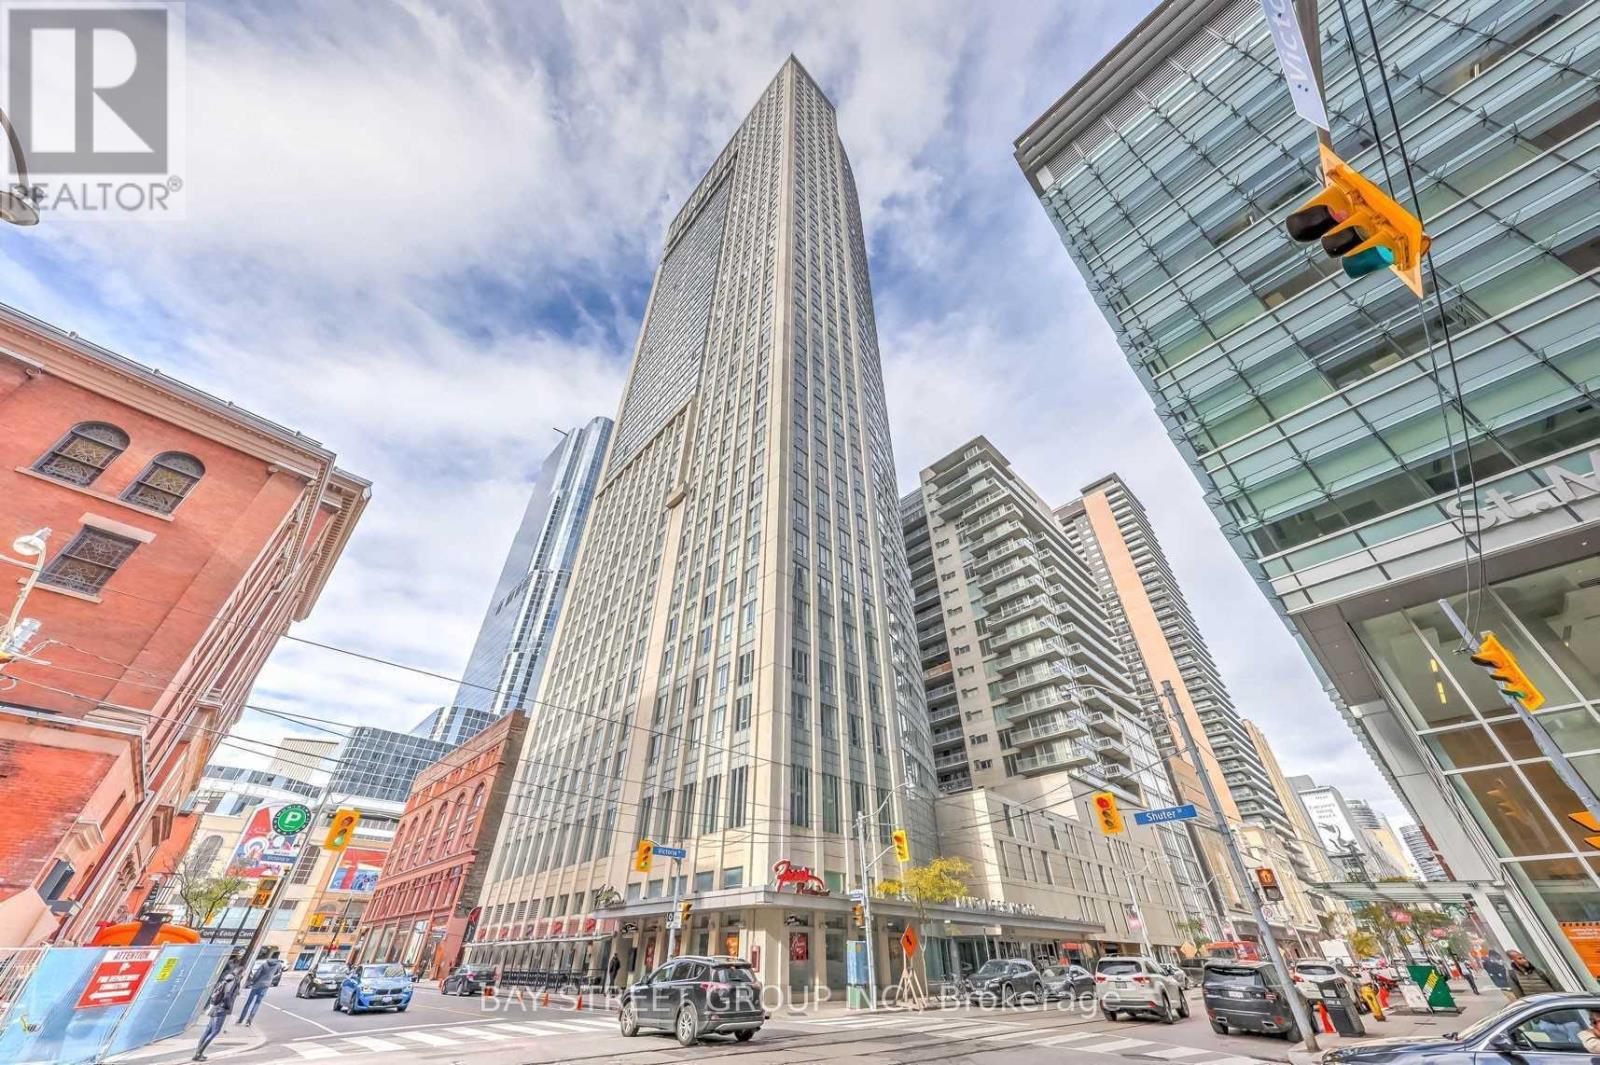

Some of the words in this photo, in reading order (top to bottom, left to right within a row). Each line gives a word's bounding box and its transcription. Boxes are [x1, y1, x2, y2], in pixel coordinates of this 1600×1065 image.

[1447, 488, 1549, 533] St.
[284, 811, 302, 825] P
[1146, 810, 1176, 822] Shuter
